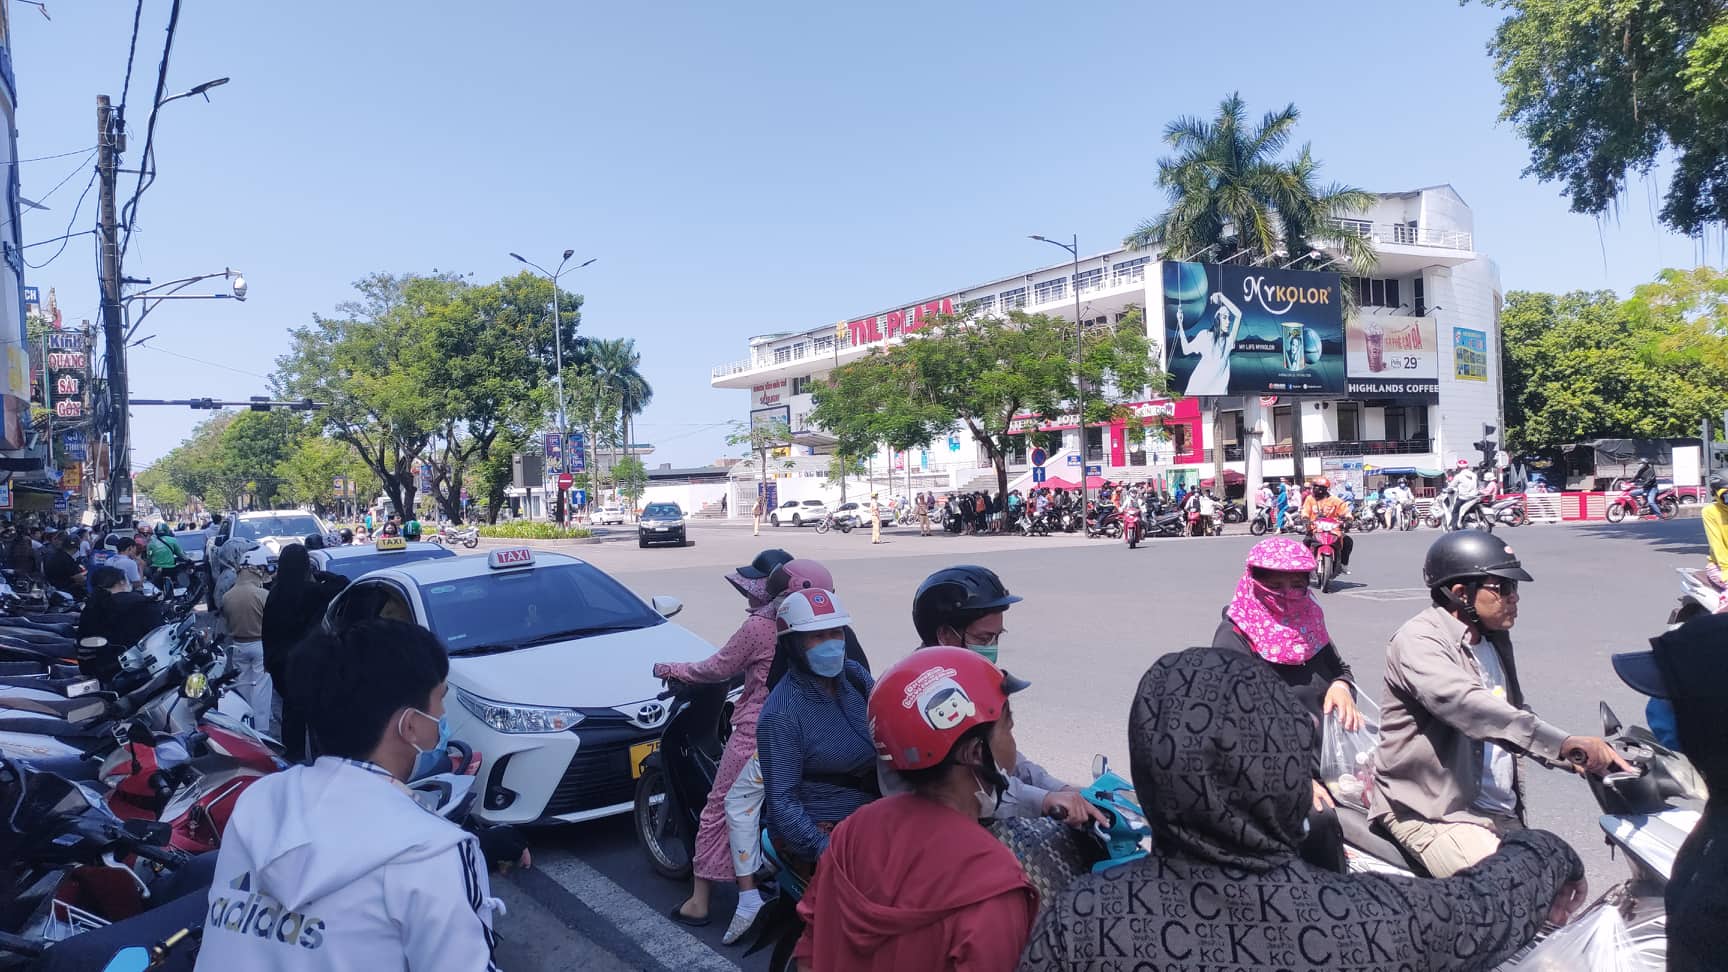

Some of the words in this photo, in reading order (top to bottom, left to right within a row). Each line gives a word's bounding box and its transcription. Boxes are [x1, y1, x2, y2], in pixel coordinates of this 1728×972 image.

[848, 316, 883, 347] TNL
[48, 352, 86, 370] QUANG
[1403, 356, 1418, 369] 29
[1348, 383, 1404, 393] HIGHLANDS
[1406, 384, 1440, 393] COFFEE
[381, 538, 403, 547] TAXI
[500, 549, 530, 562] TAXI
[210, 893, 327, 950] adidas
